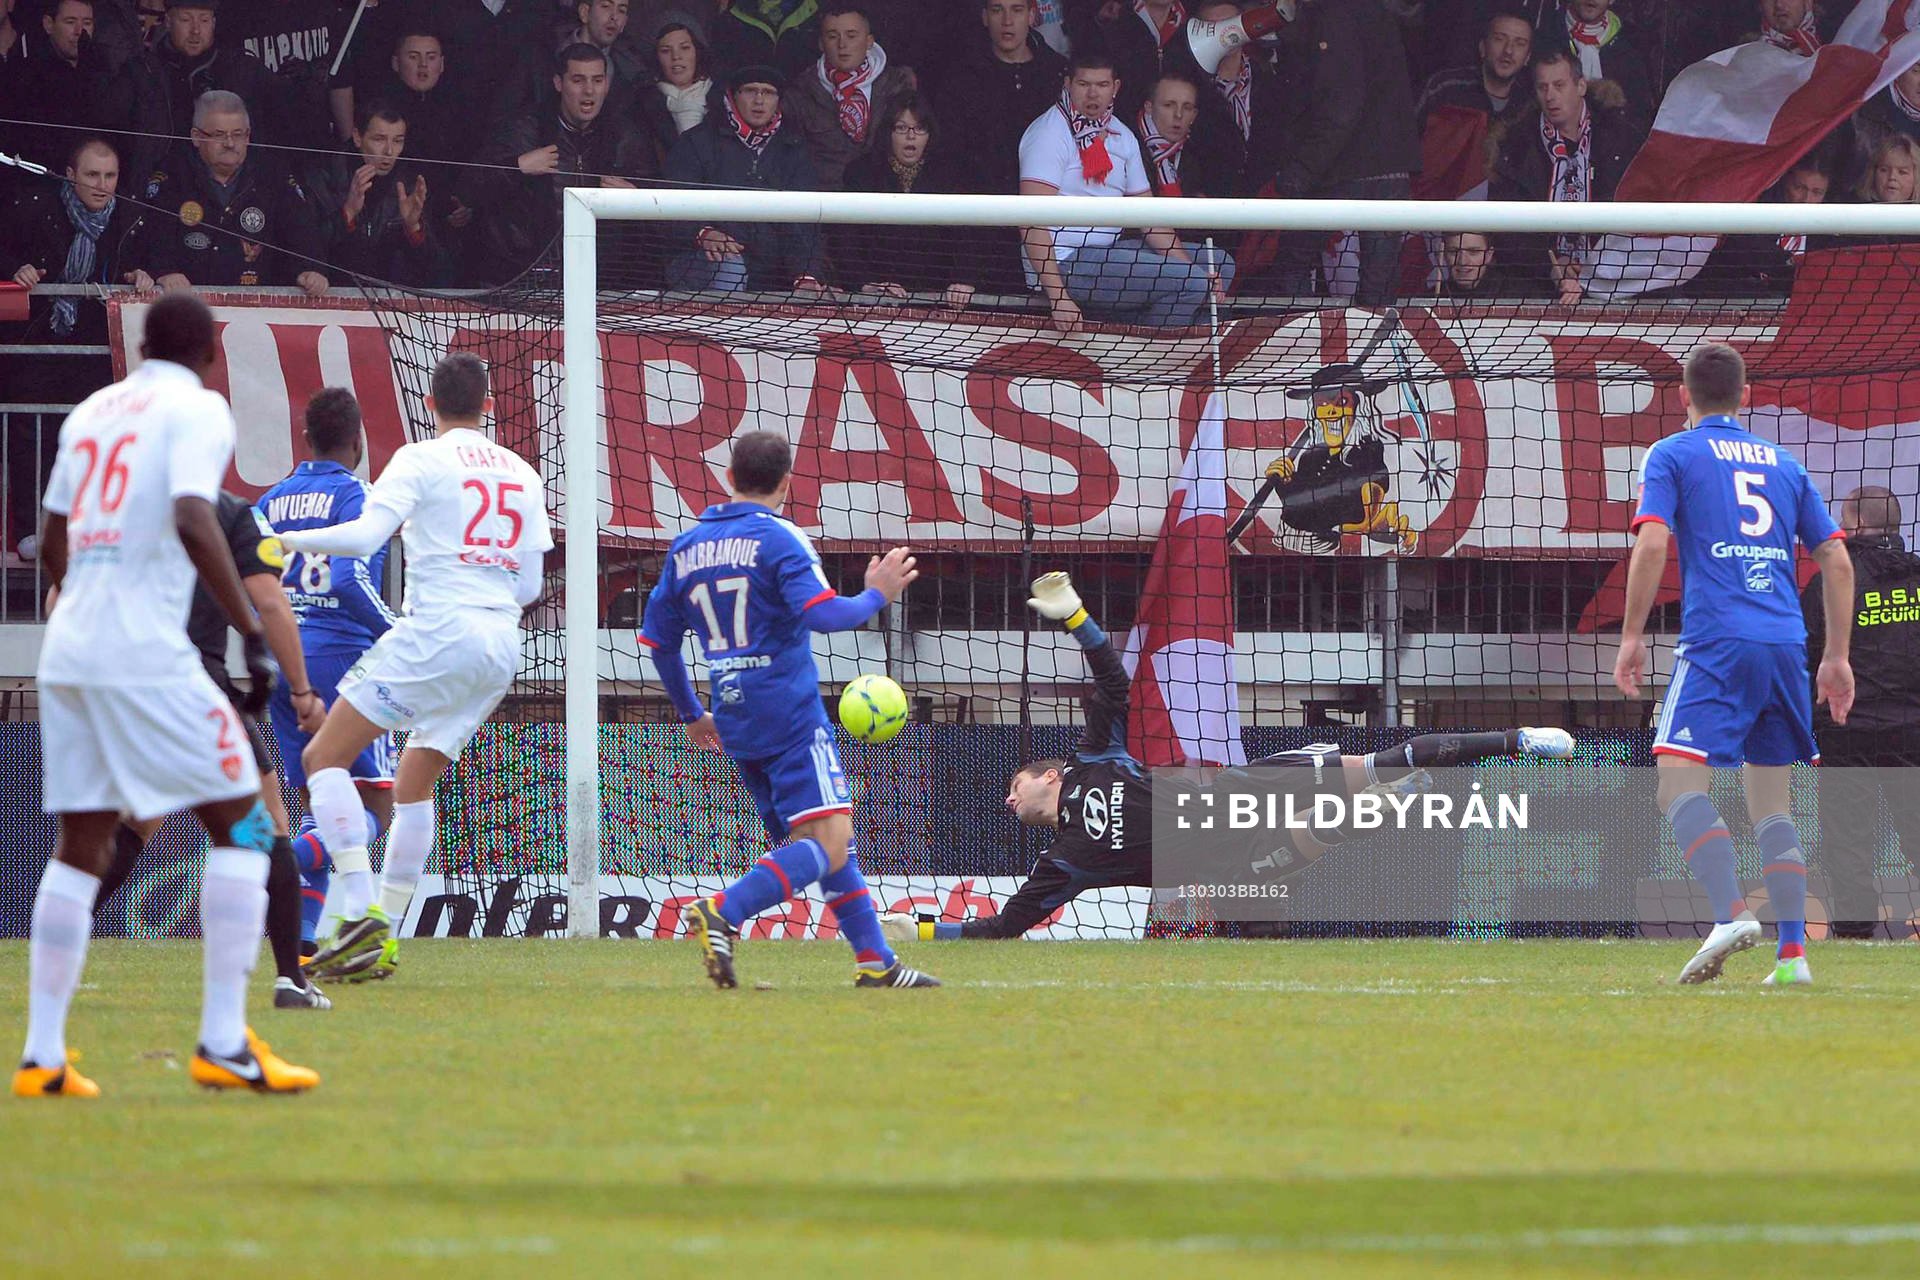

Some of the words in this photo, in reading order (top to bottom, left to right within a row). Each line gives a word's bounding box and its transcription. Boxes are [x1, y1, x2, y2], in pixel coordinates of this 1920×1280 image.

[70, 431, 138, 523] 26
[1708, 438, 1777, 467] LOVREN
[268, 492, 334, 525] MVUEMBA
[463, 478, 524, 549] 25
[1733, 469, 1773, 537] 5
[673, 537, 762, 580] MALBRANQUE
[1711, 541, 1788, 561] Groupam
[688, 576, 750, 652] 17
[1865, 588, 1920, 608] B.S.
[1110, 781, 1125, 850] HYUNDAI
